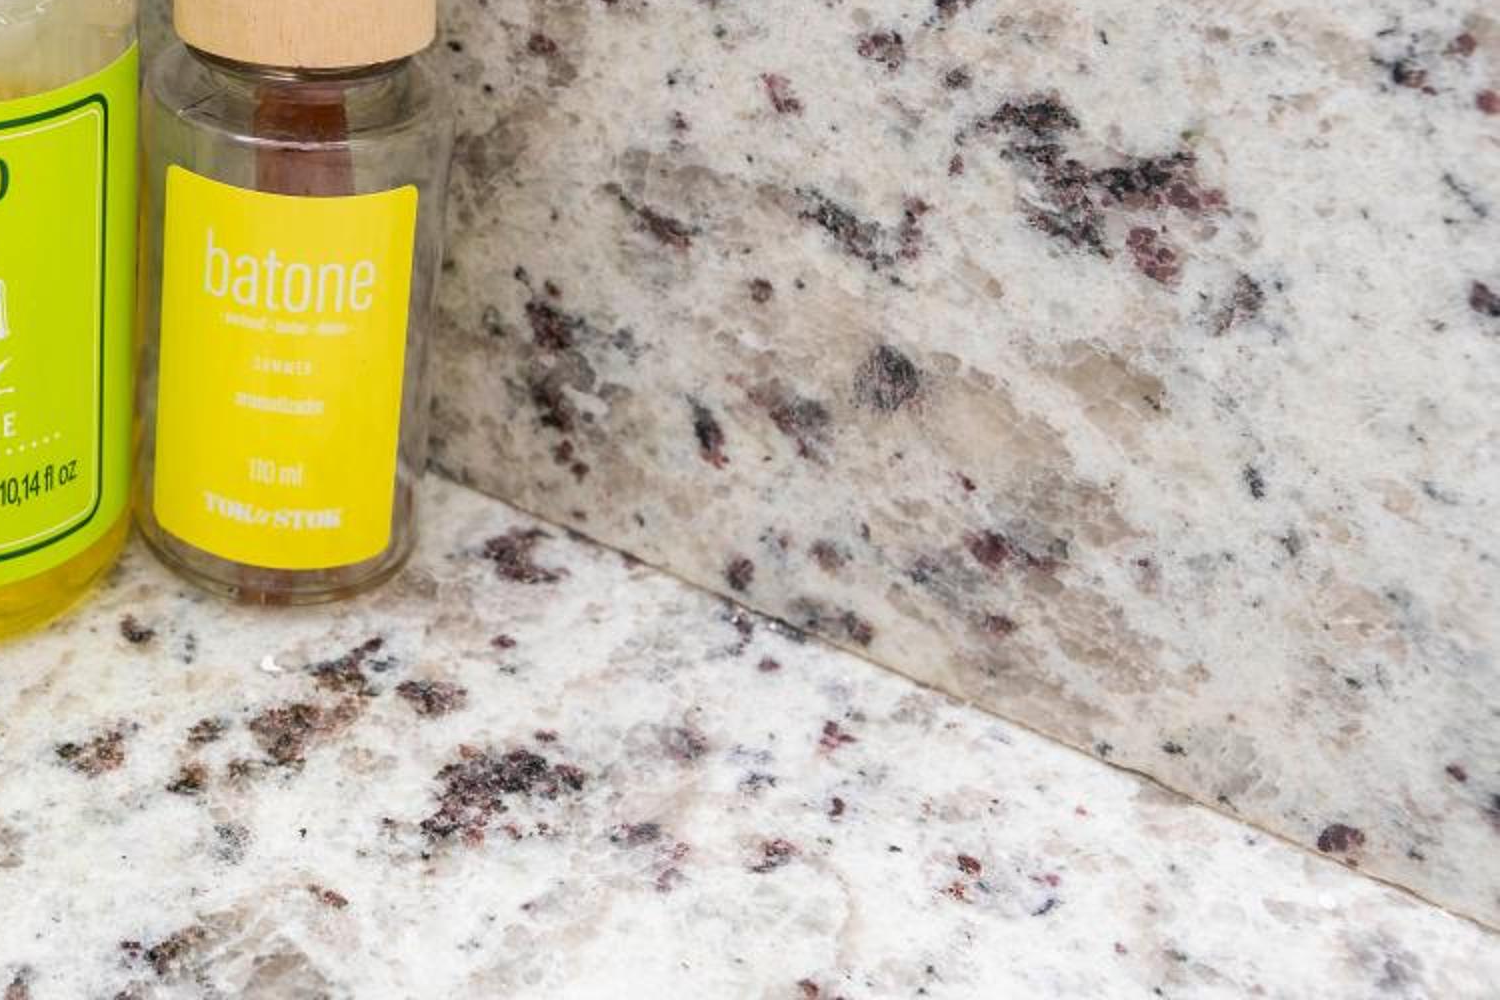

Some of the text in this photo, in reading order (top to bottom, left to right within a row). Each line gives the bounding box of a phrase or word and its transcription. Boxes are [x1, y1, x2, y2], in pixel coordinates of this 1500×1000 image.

[203, 226, 376, 313] batone
[44, 464, 54, 493] fl
[59, 459, 78, 486] oz
